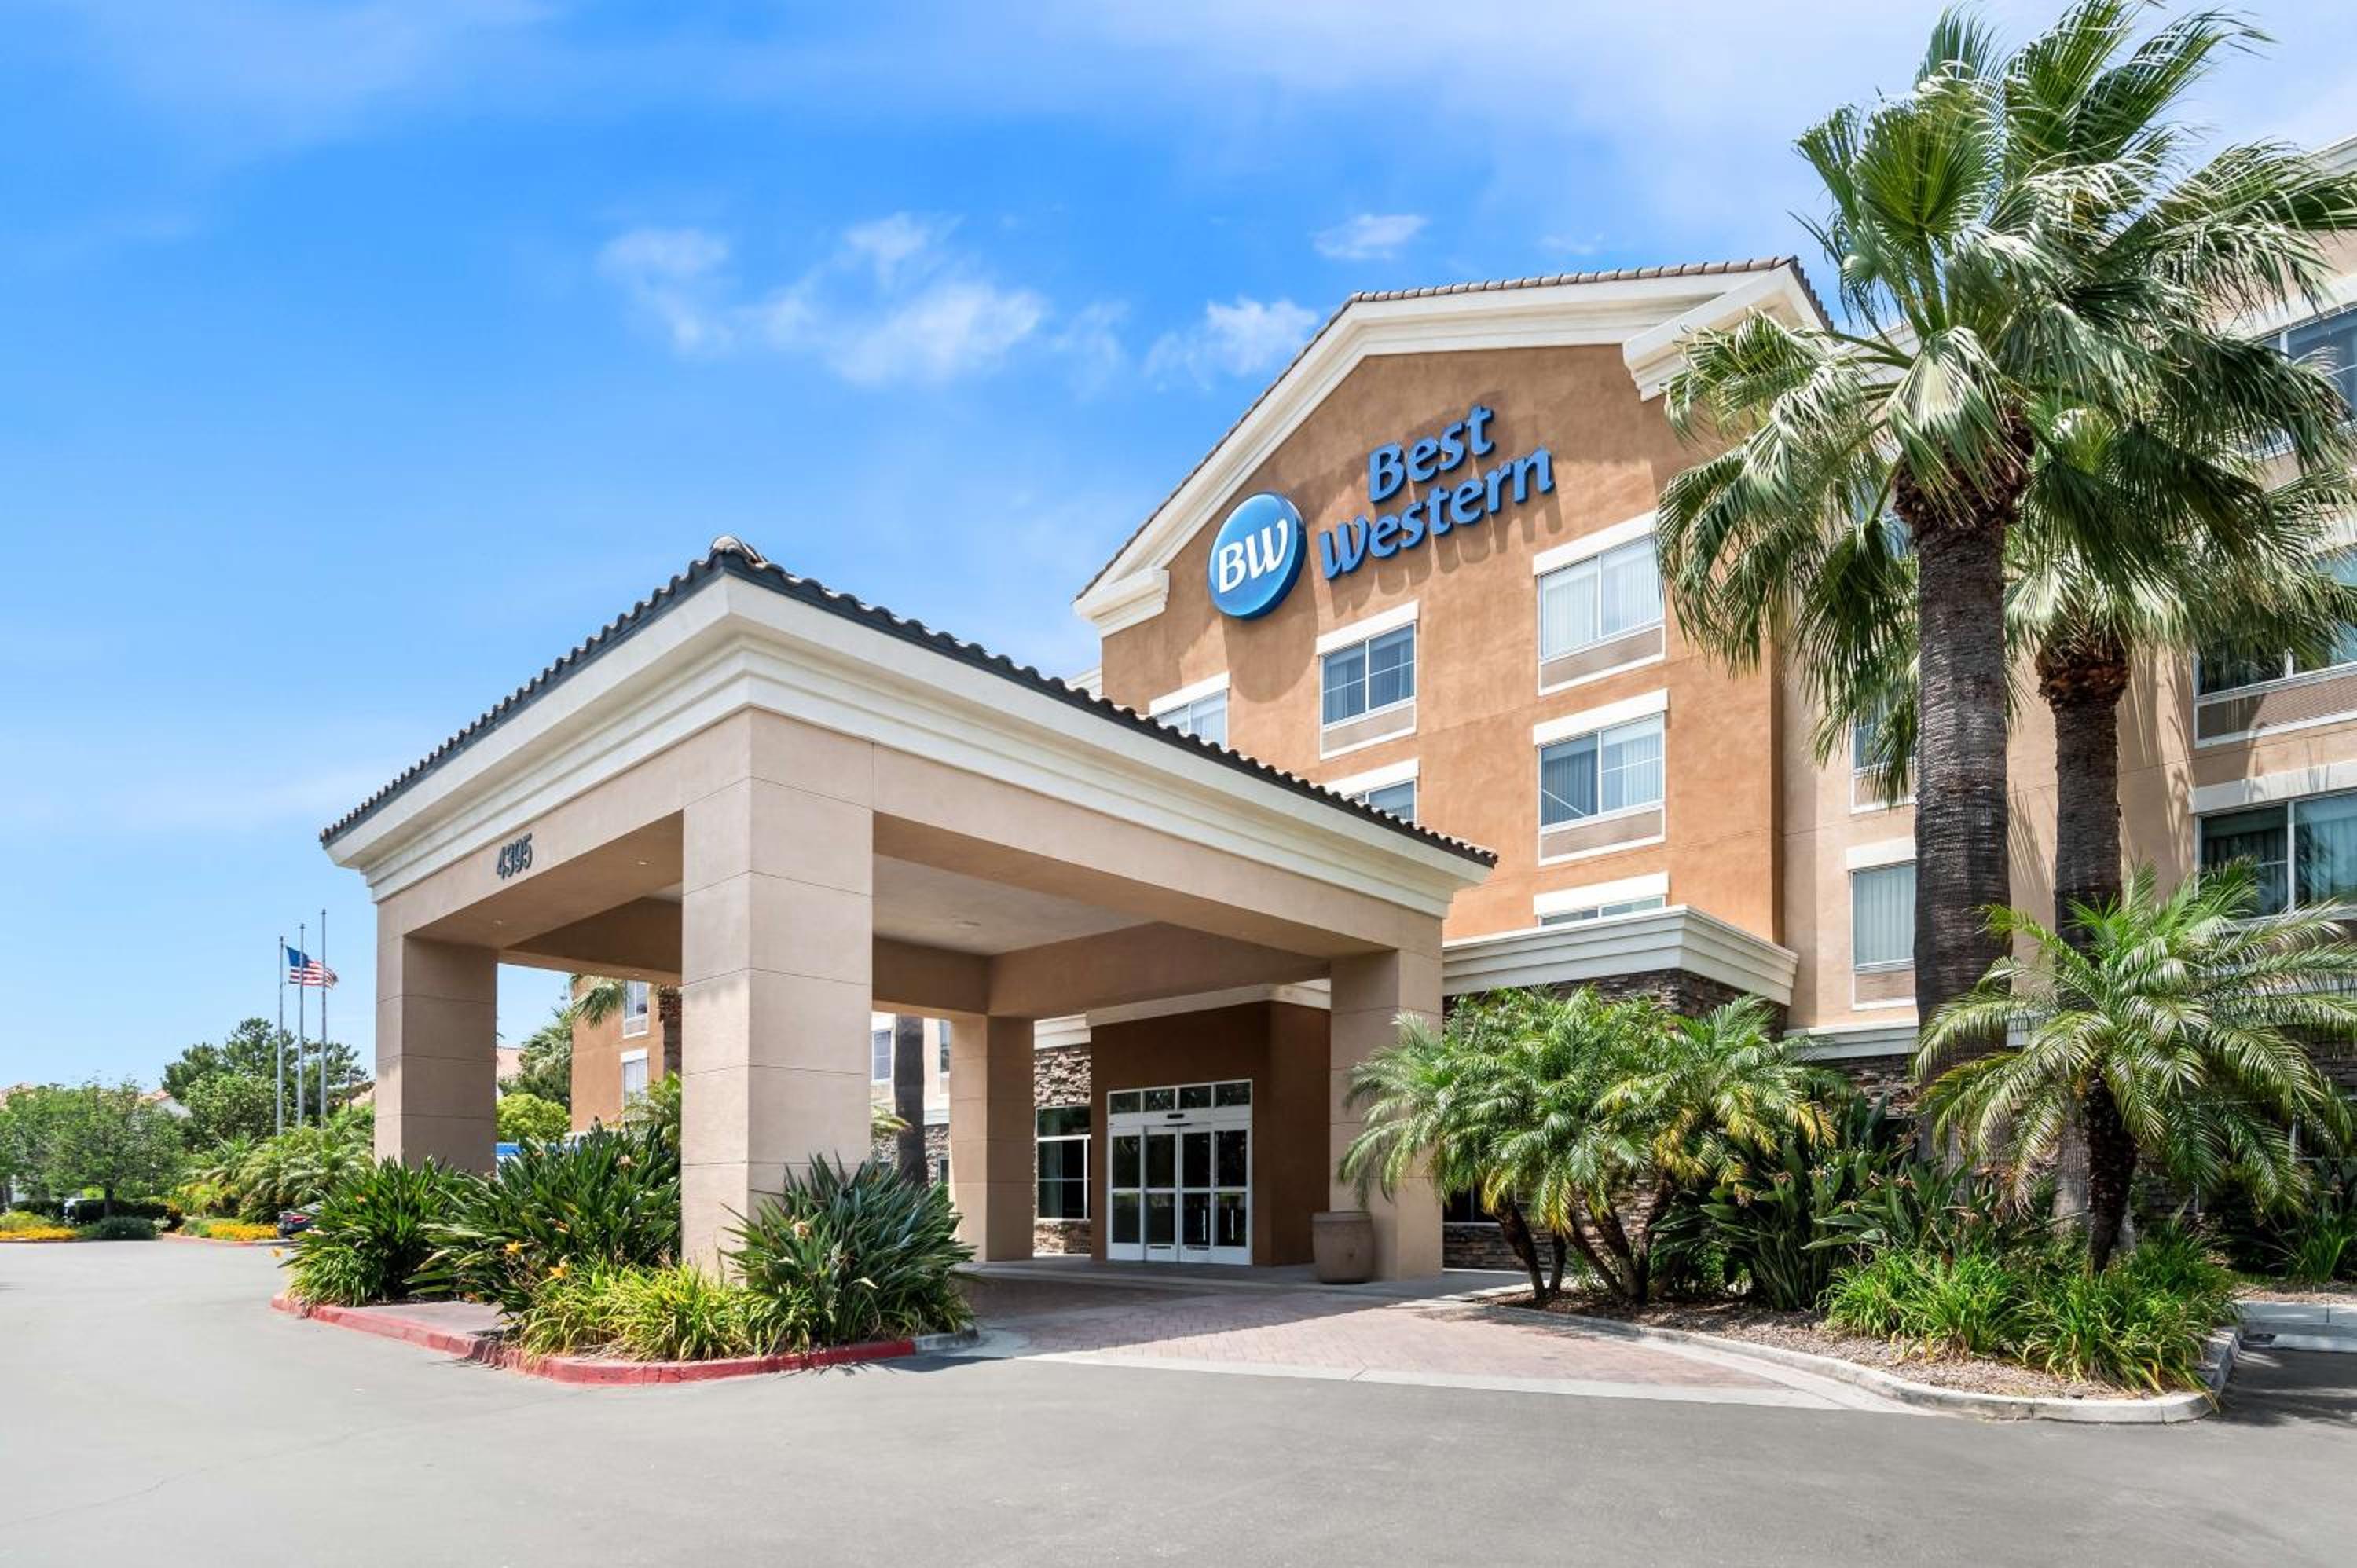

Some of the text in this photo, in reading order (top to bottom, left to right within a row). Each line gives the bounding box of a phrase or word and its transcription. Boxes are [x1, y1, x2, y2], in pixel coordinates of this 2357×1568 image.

[1369, 404, 1494, 503] Best
[1219, 519, 1288, 593] BW
[1318, 447, 1555, 580] Western
[497, 833, 533, 880] 4395
